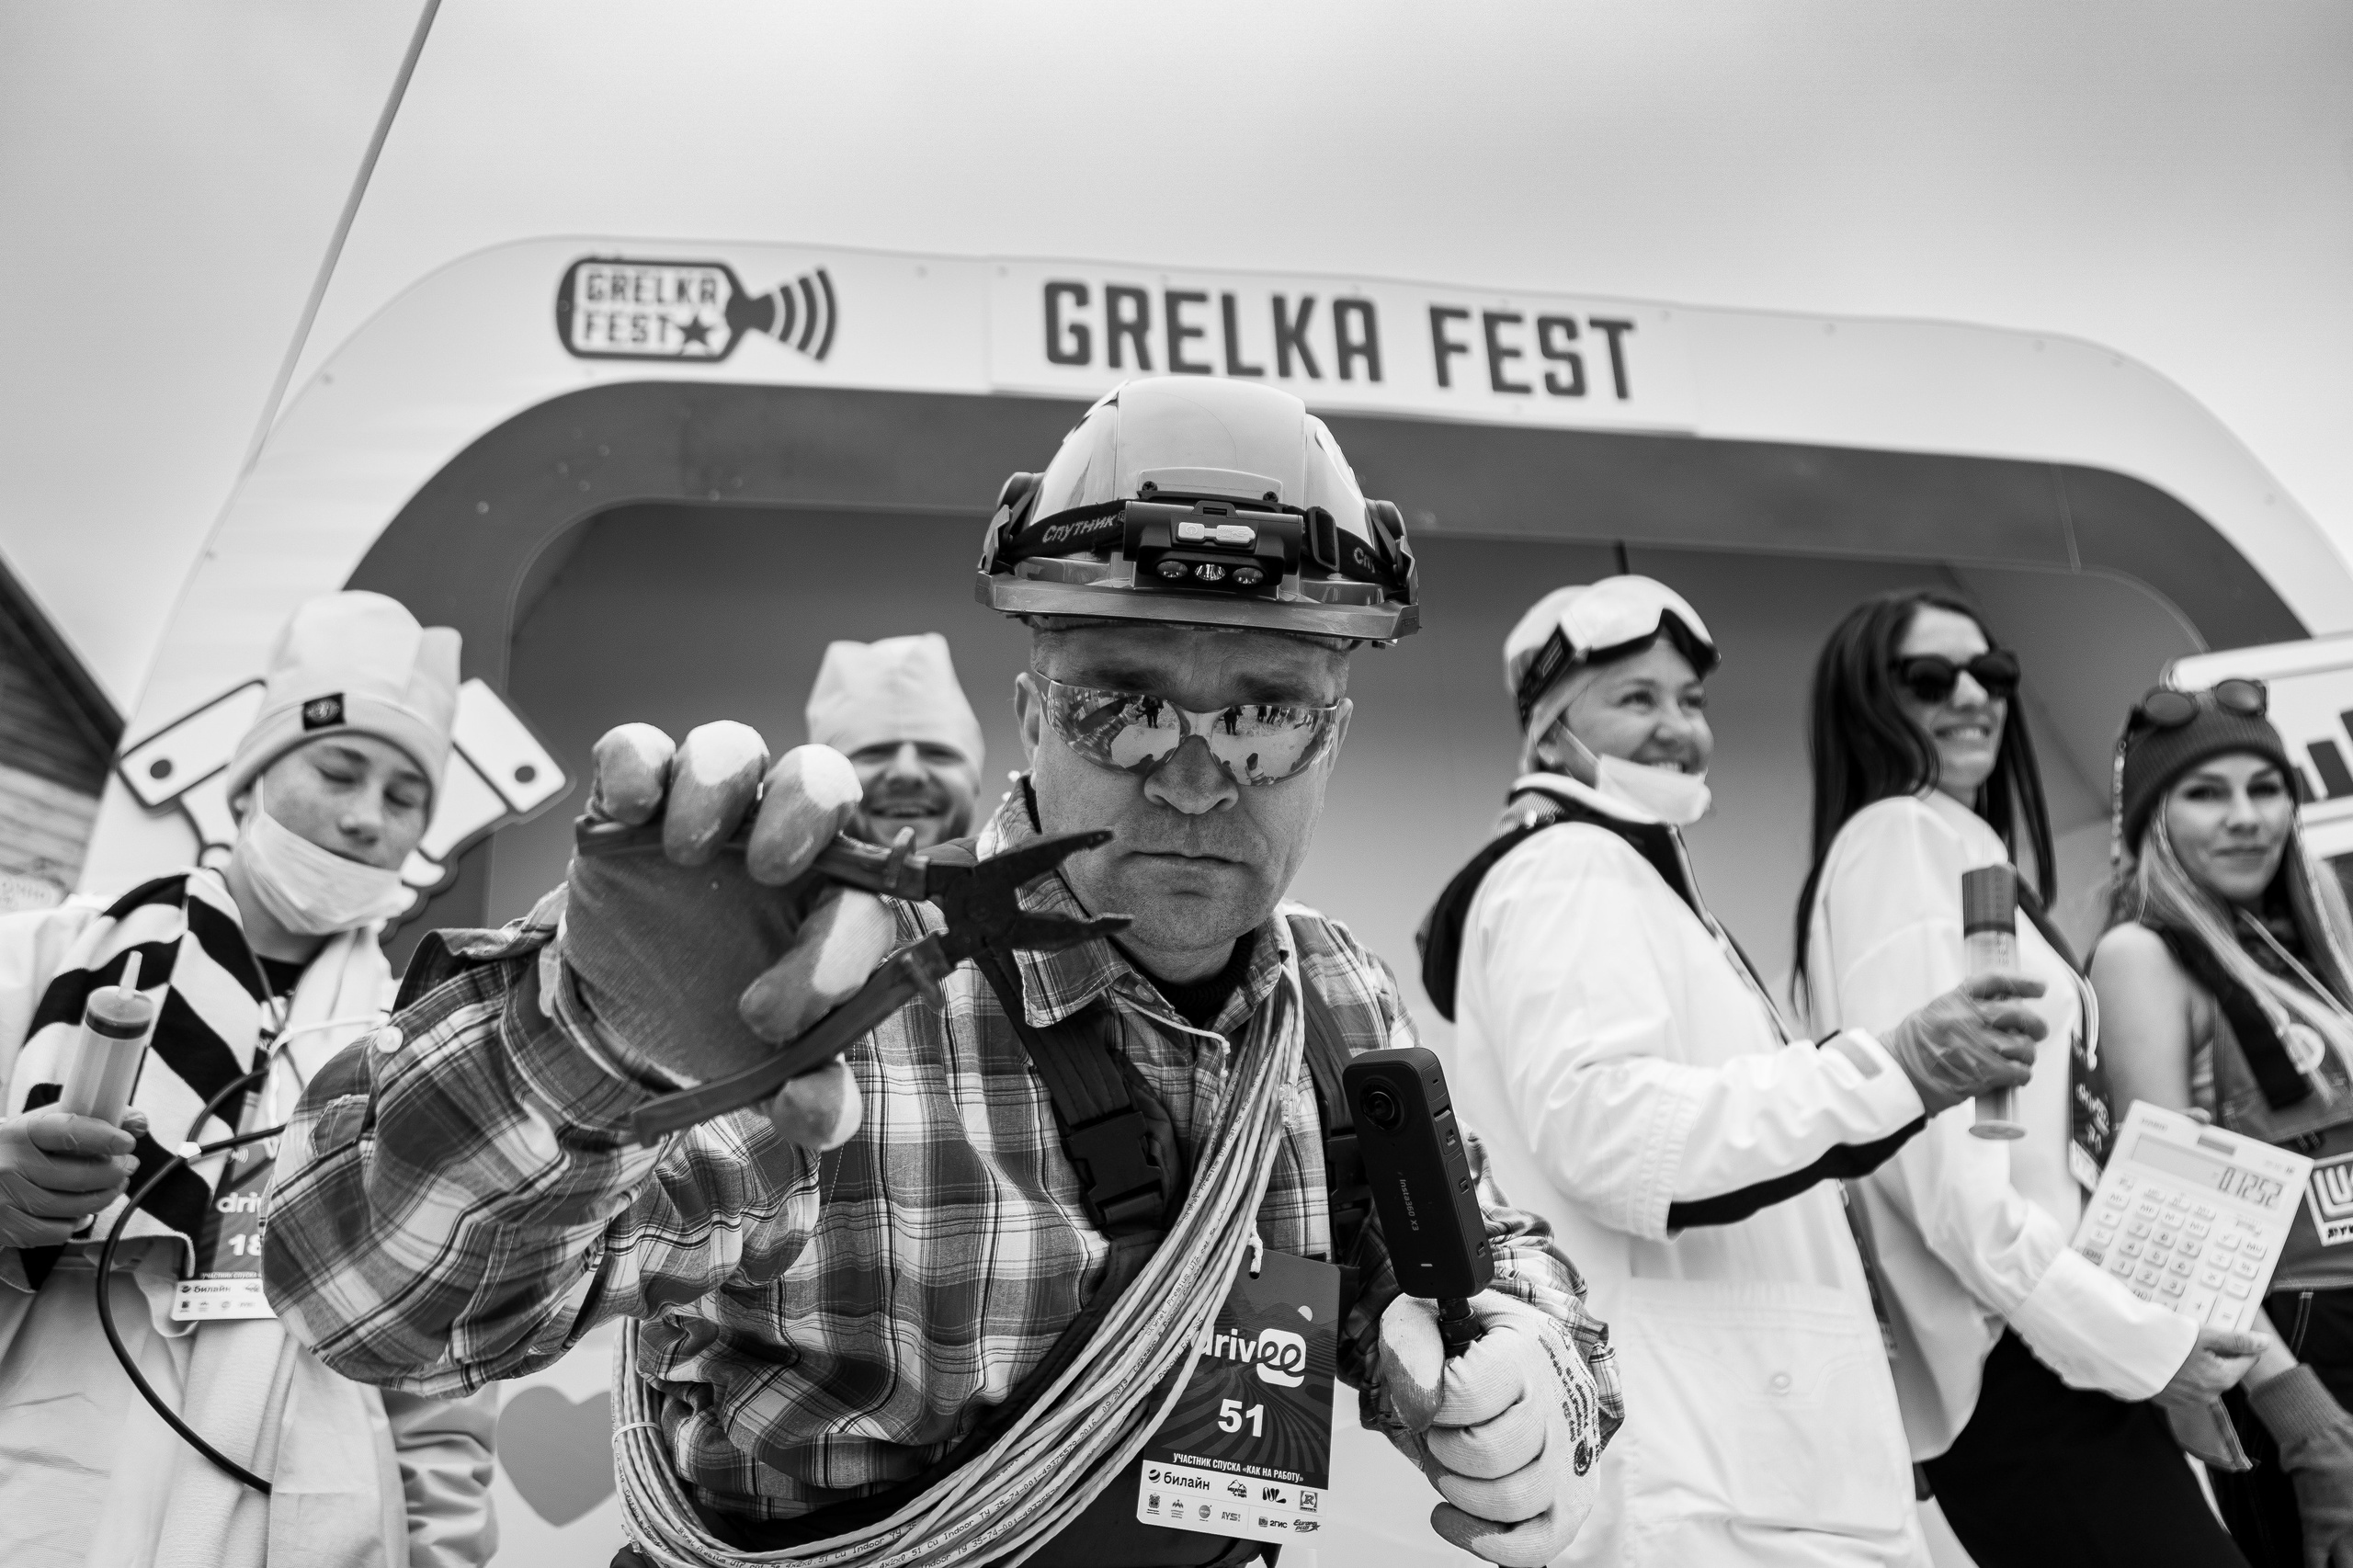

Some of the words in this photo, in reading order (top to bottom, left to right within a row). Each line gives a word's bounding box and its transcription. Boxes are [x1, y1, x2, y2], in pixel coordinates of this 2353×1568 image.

[586, 272, 717, 305] GRELKA
[585, 312, 671, 344] FEST
[1043, 280, 1384, 383] GRELKA
[1428, 302, 1635, 401] FEST
[1219, 1144, 1228, 1157] UTP
[1228, 1128, 1237, 1141] cat
[1235, 1115, 1243, 1124] 5e
[1399, 1179, 1415, 1217] Insta360
[1410, 1220, 1419, 1231] X3
[1145, 1310, 1167, 1336] Skynet
[1167, 1273, 1190, 1306] Premium
[1188, 1256, 1200, 1271] UTP
[1200, 1241, 1210, 1255] cat
[1209, 1228, 1216, 1237] 5e
[1218, 1398, 1264, 1437] 51
[1164, 1471, 1211, 1490] билайн
[1173, 1453, 1211, 1468] УЧАСТНИК
[1212, 1460, 1241, 1471] СПУСКА
[1243, 1465, 1261, 1476] «КАК
[1262, 1468, 1272, 1477] НА
[1273, 1470, 1303, 1483] РАБОТУ»
[926, 1539, 939, 1549] Cu
[944, 1520, 974, 1540] Indoor
[1269, 1519, 1288, 1528] 2ГИС
[677, 1526, 695, 1546] Skynet
[696, 1545, 726, 1564] Premium
[853, 1538, 885, 1553] Indoor
